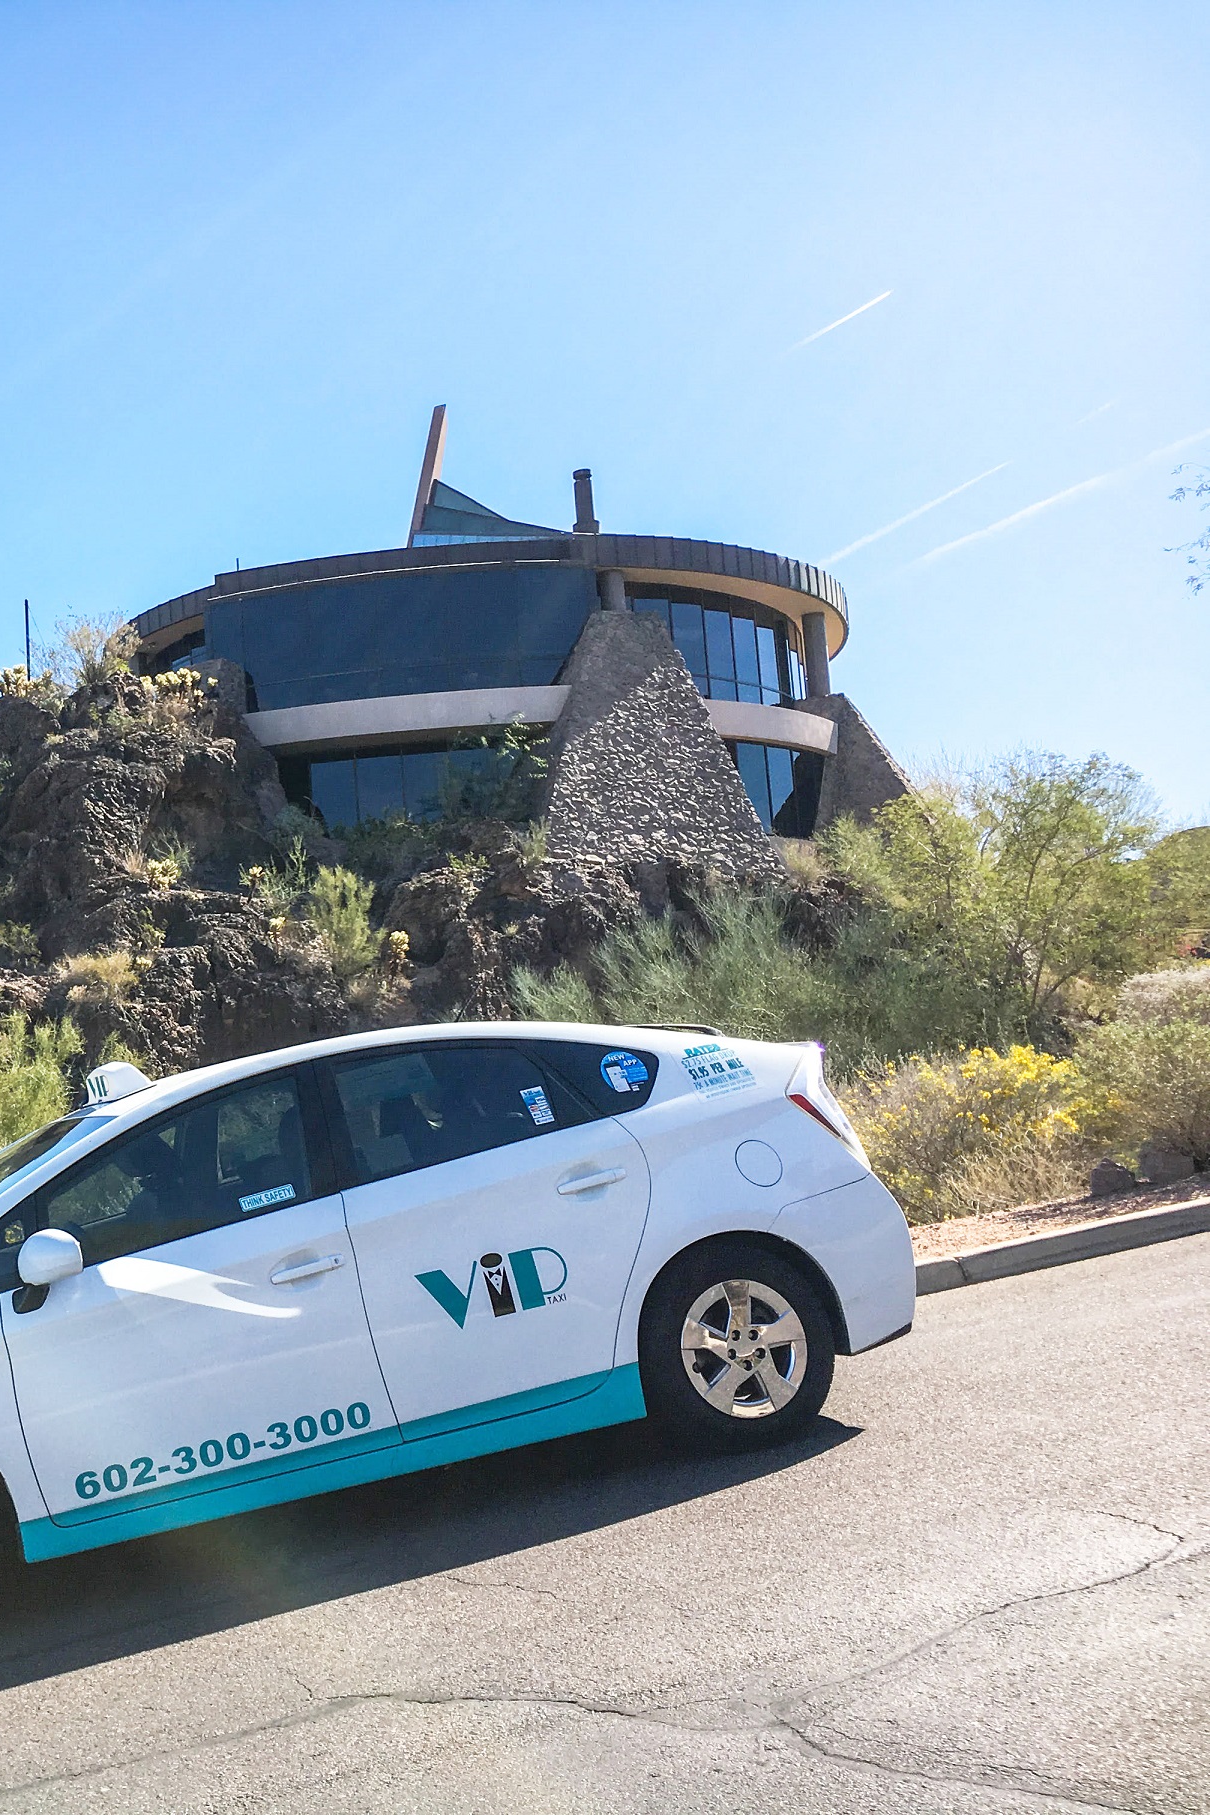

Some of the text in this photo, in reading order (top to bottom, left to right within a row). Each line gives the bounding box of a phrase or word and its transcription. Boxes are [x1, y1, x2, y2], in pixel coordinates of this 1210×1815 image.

[684, 1044, 721, 1057] RATES
[608, 1053, 626, 1062] NEW
[623, 1059, 638, 1067] APP
[701, 1053, 719, 1065] FLAG
[688, 1057, 745, 1080] $1.95 PER MILE
[241, 1187, 292, 1209] THINK SAFETY
[546, 1292, 567, 1305] TAXI
[75, 1401, 371, 1500] 602-300-3000
